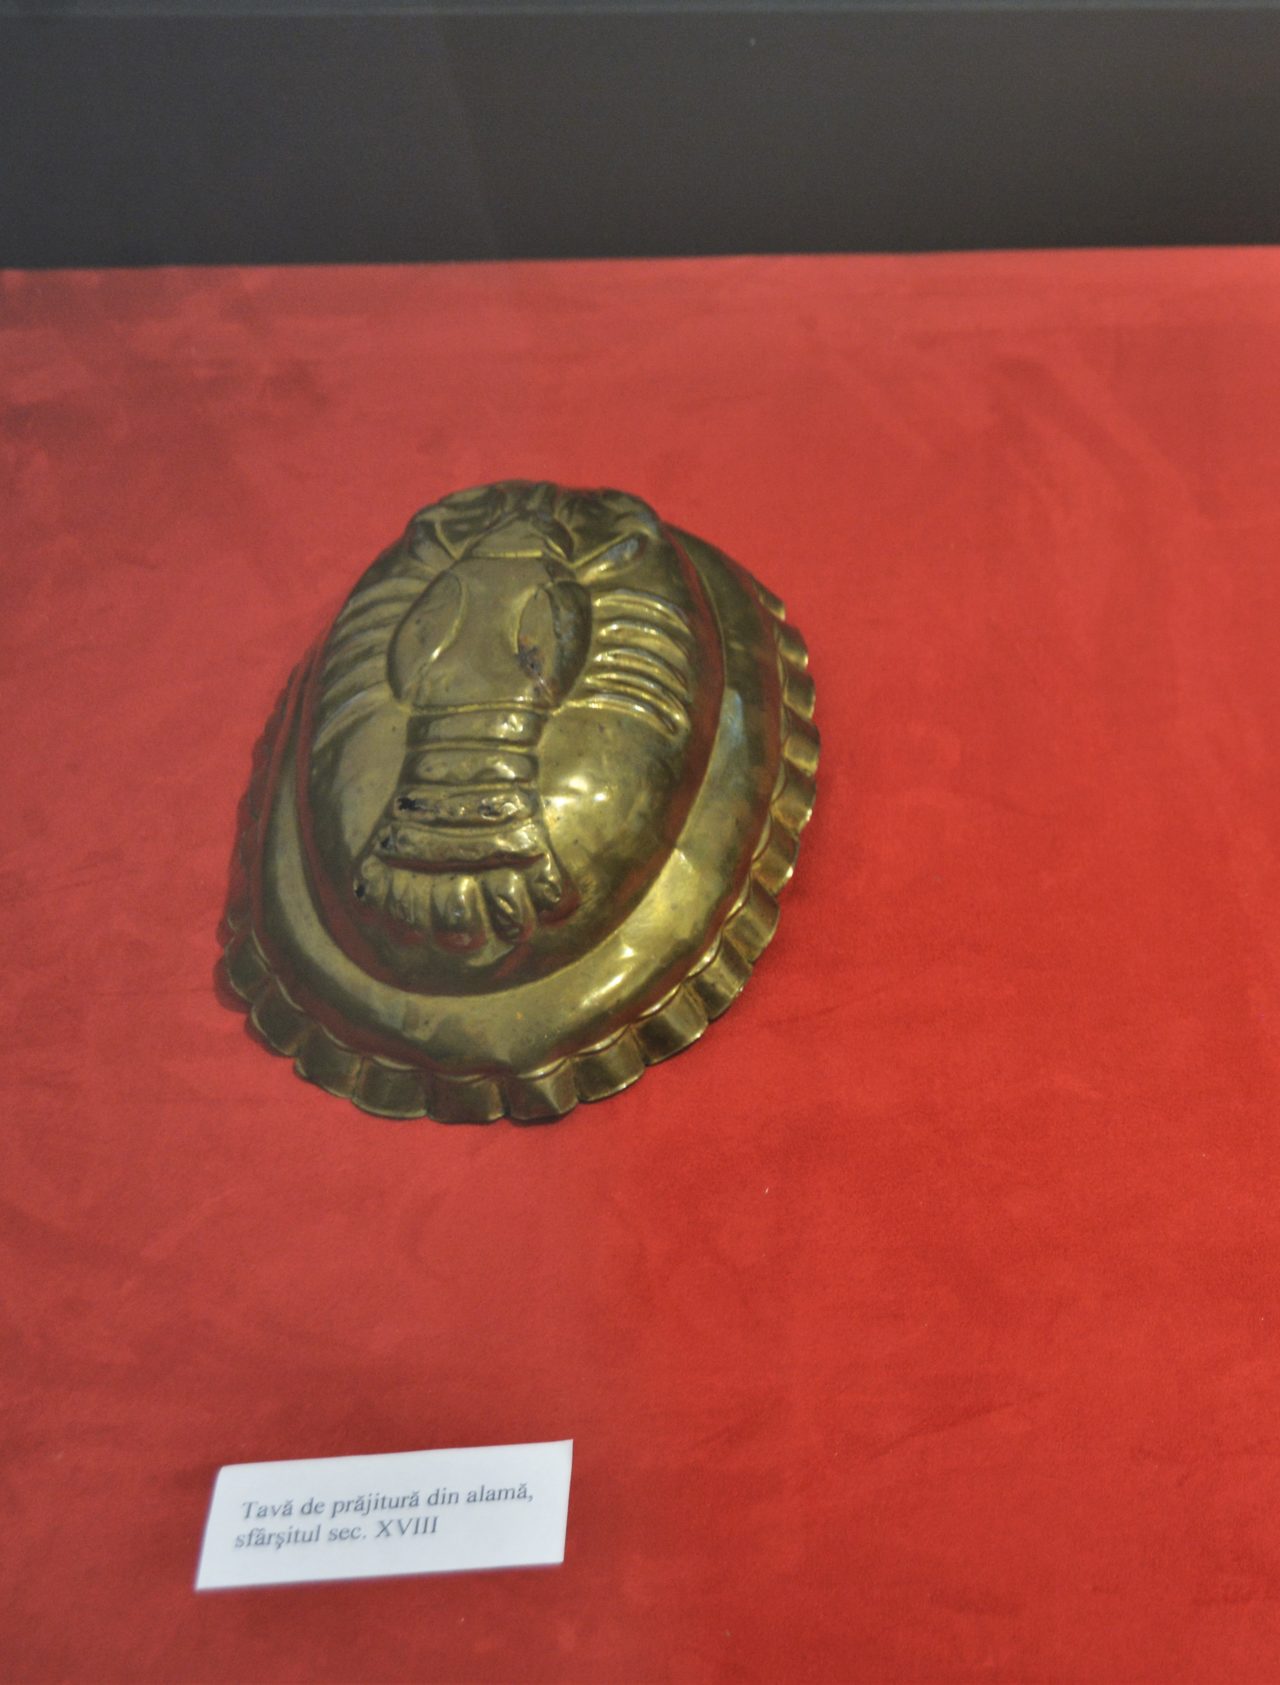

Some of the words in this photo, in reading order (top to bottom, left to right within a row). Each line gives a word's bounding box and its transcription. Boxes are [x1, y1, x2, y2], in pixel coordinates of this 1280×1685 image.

[243, 1500, 294, 1519] Tavă
[300, 1497, 326, 1517] de
[331, 1490, 420, 1520] prăjitură
[426, 1487, 460, 1506] din
[465, 1482, 534, 1504] alamă,
[328, 1527, 368, 1542] sec.
[374, 1516, 440, 1538] XVIII
